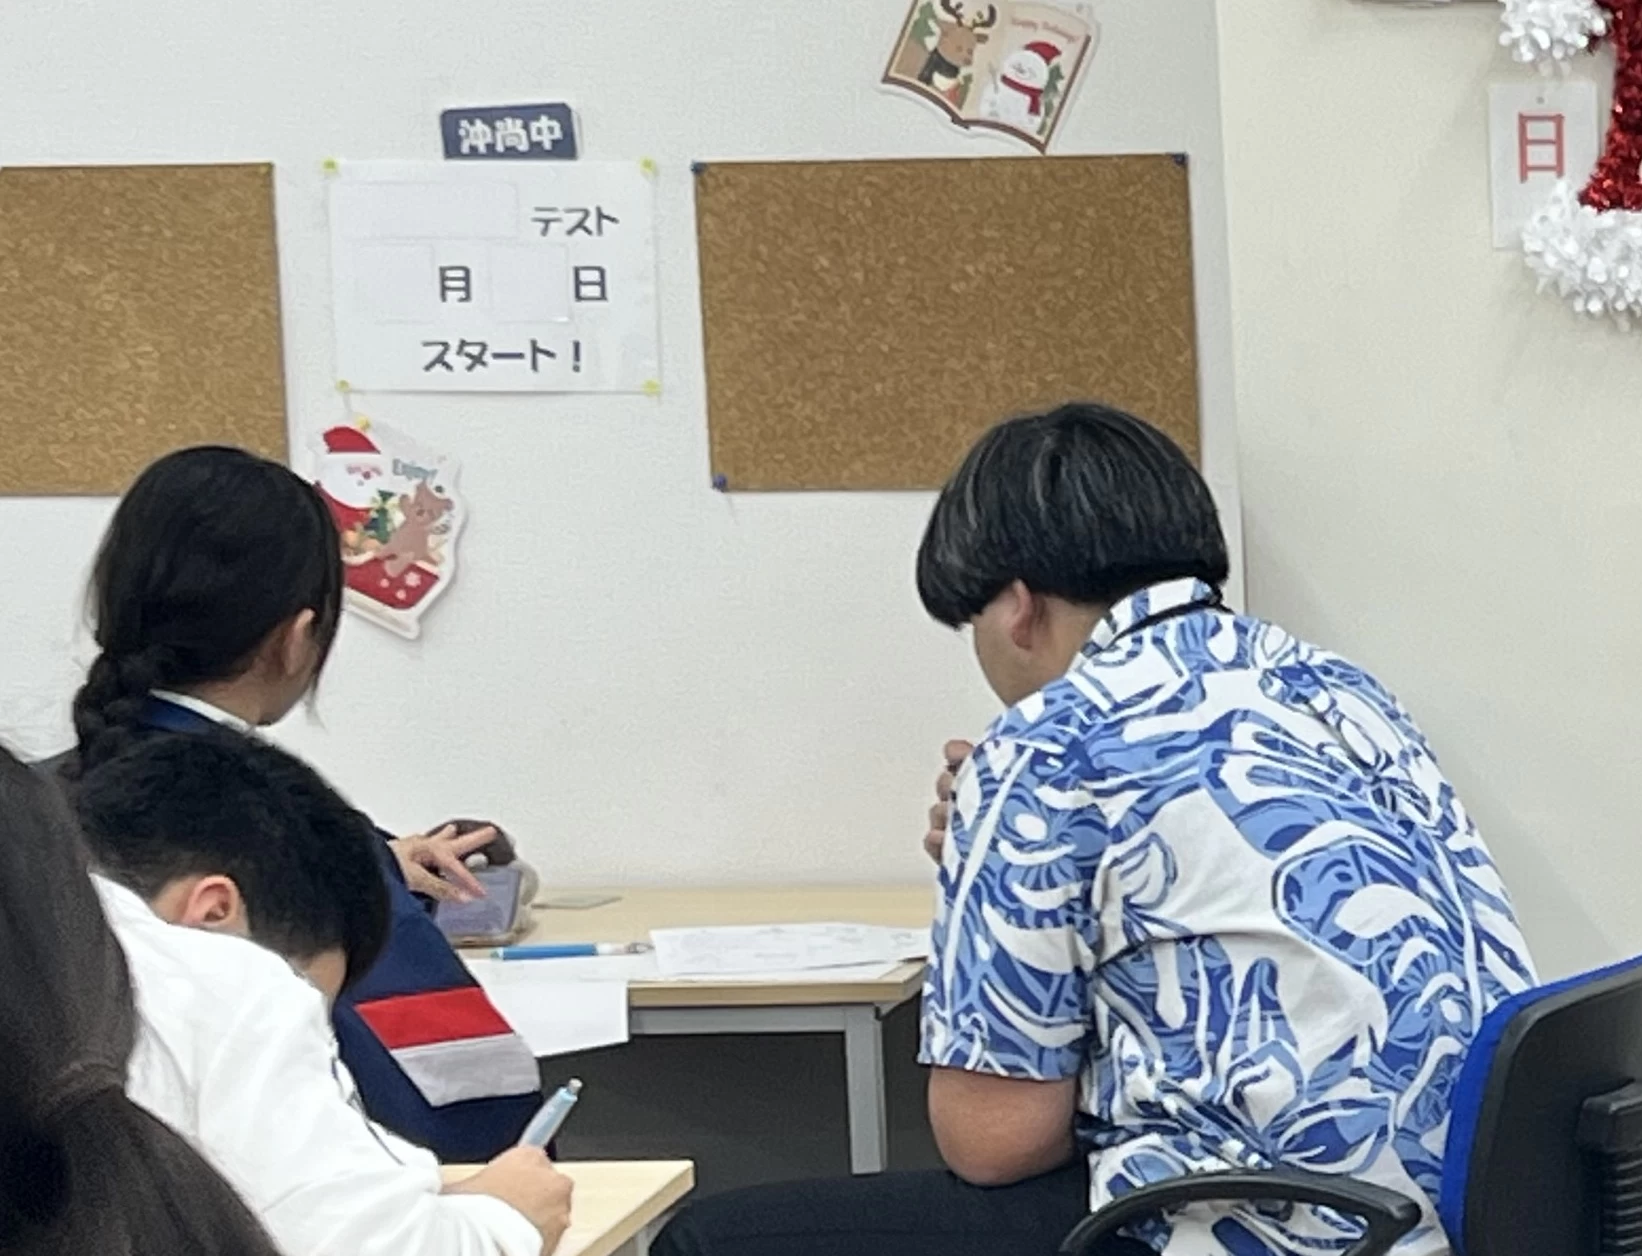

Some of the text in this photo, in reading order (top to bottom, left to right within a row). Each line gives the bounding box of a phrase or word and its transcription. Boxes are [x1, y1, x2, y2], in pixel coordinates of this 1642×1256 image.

[458, 115, 563, 154] 沖尚中
[531, 205, 620, 237] テスト
